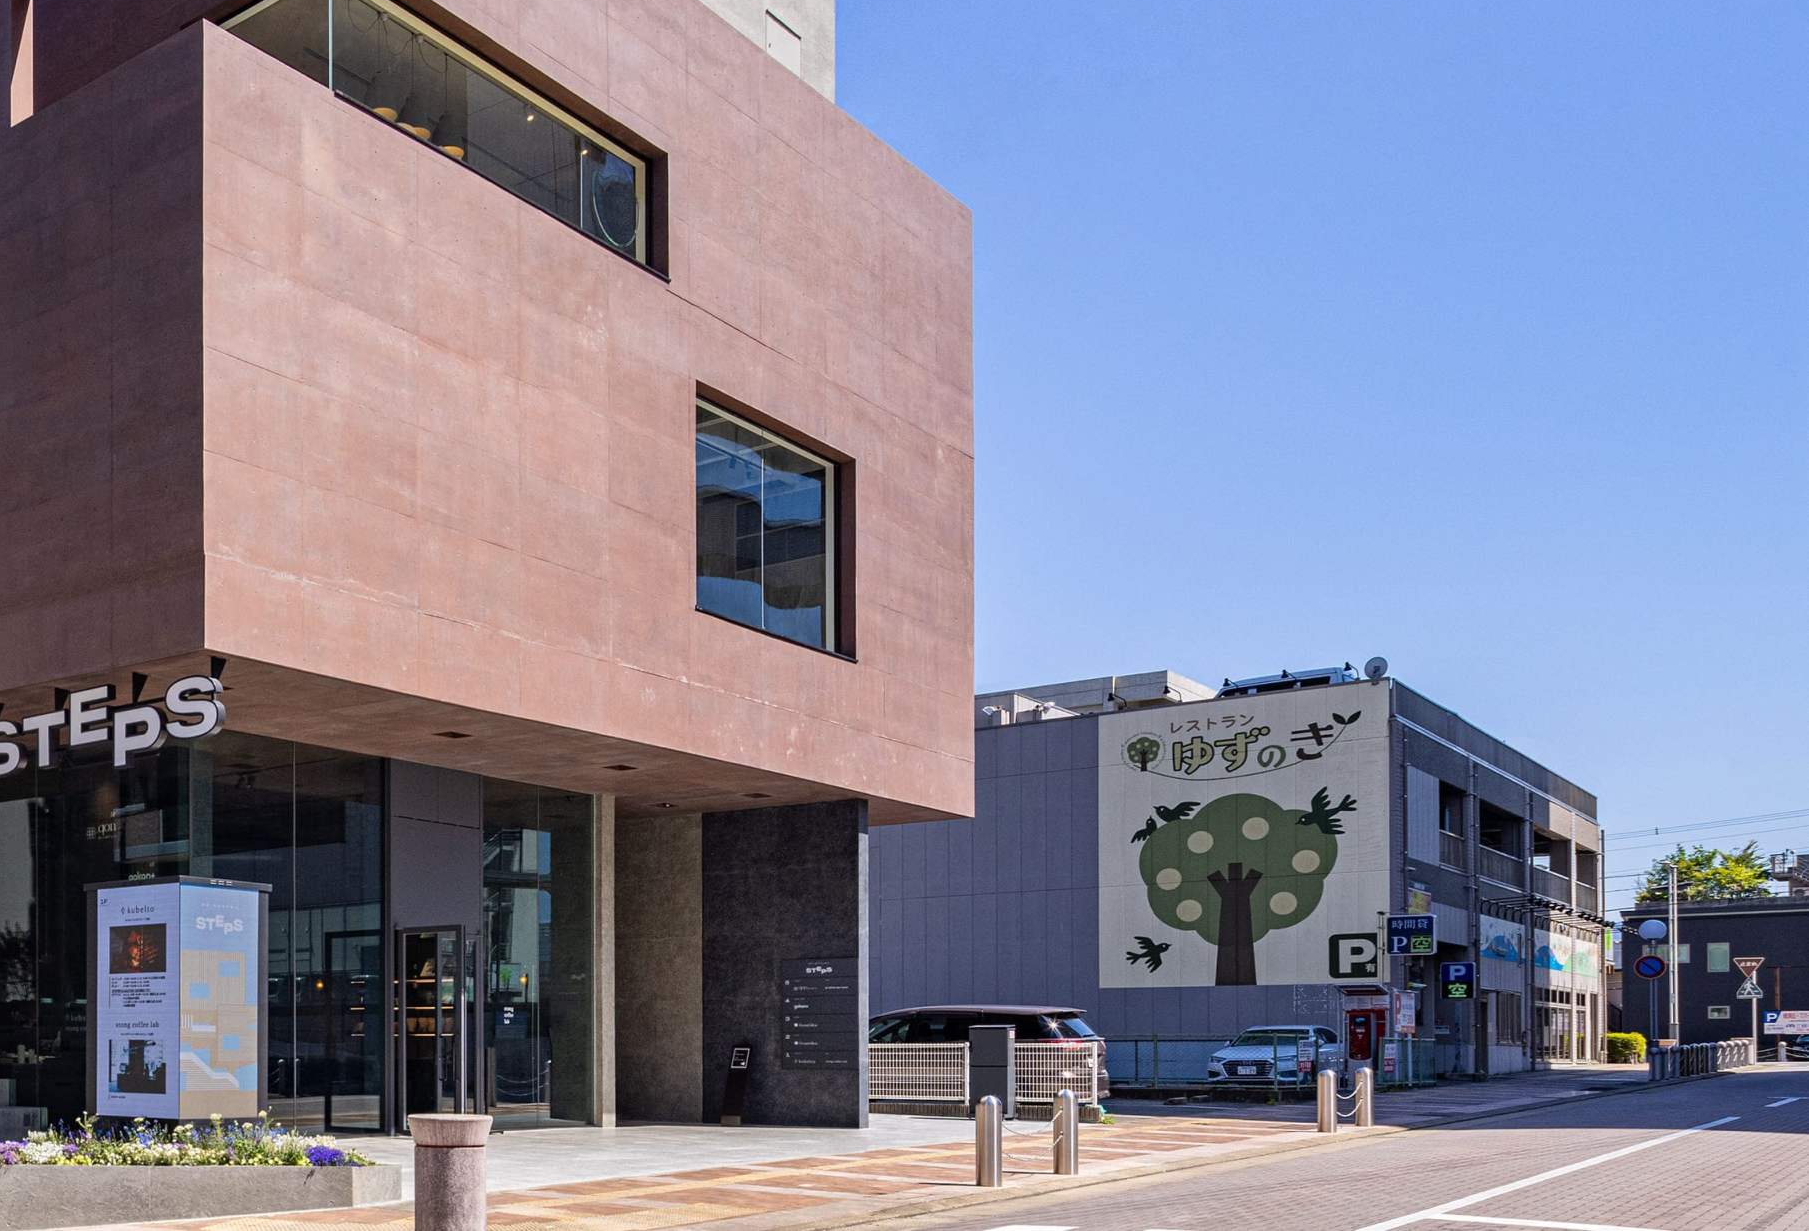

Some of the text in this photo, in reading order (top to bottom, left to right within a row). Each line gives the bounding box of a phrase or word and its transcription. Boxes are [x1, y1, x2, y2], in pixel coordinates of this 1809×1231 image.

[1170, 714, 1254, 734] レストラン
[1172, 722, 1334, 774] ゆずのき
[196, 915, 243, 935] STEPS
[1392, 919, 1428, 929] 時間貸
[1391, 936, 1432, 952] P 空
[1339, 938, 1376, 973] P
[1449, 965, 1466, 980] P
[1448, 983, 1467, 998] 空
[1766, 1013, 1777, 1022] P
